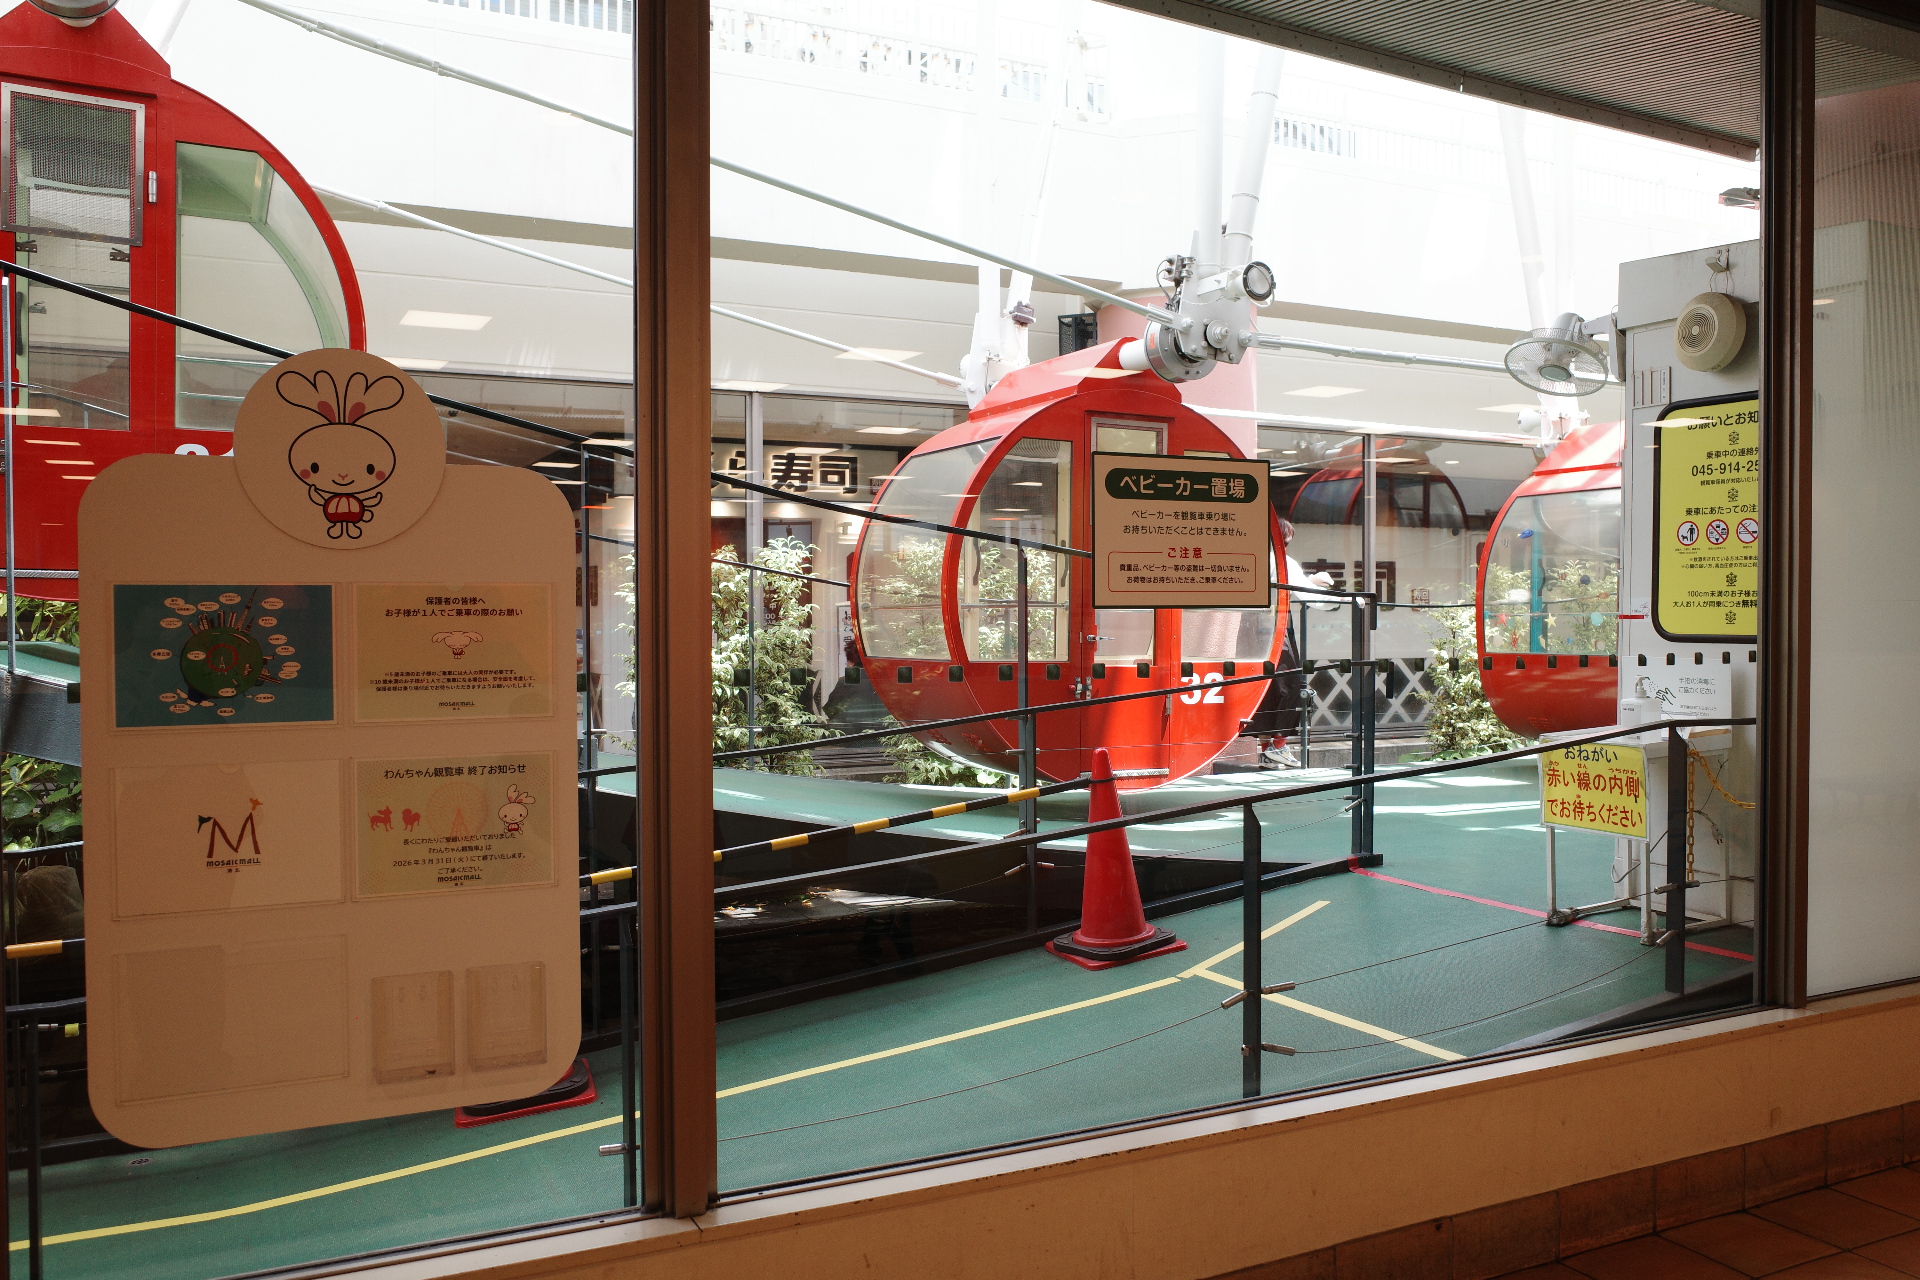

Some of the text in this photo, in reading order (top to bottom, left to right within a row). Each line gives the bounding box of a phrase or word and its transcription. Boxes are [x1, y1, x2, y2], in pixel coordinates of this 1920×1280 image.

[1119, 474, 1246, 499] ベビーカー置場
[1131, 509, 1236, 522] ベビーカーを観覧車乗り場に
[1122, 525, 1247, 537] お持ちいただくことはできません。
[1167, 546, 1203, 559] ご注意
[425, 596, 486, 606] 保護者の皆様へ
[1180, 672, 1225, 705] 32
[1564, 746, 1619, 763] おねがい
[384, 763, 527, 779] わんちゃん観覧車 終了お知らせ
[1547, 767, 1641, 798] 赤い線の内側
[1546, 797, 1643, 828] でお待ちください
